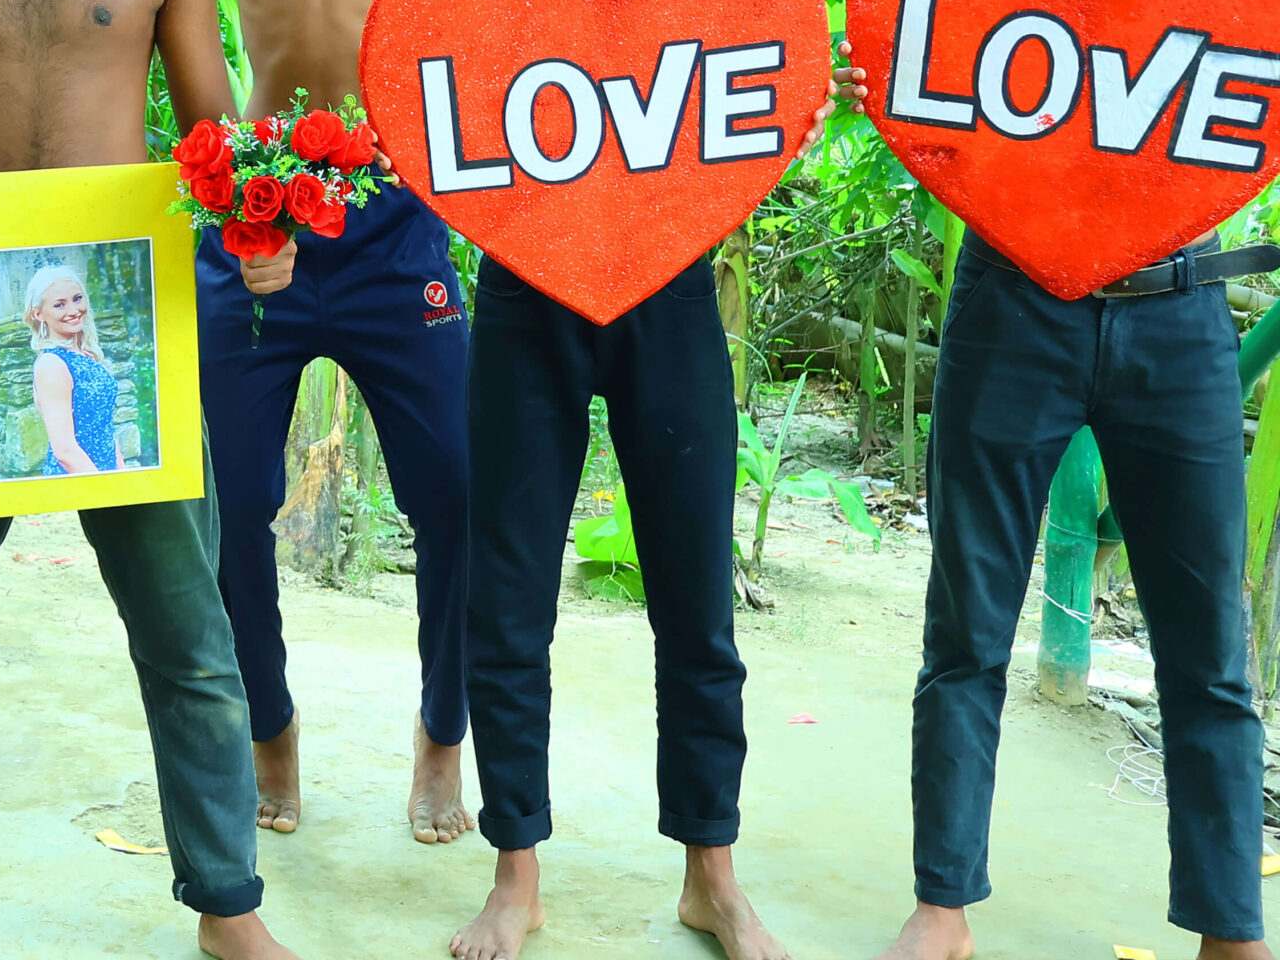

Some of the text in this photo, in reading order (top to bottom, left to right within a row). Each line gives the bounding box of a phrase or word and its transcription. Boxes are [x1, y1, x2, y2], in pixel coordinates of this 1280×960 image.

[419, 40, 784, 195] LOVE
[424, 305, 460, 320] ROYAL
[425, 313, 462, 327] SPORTS
